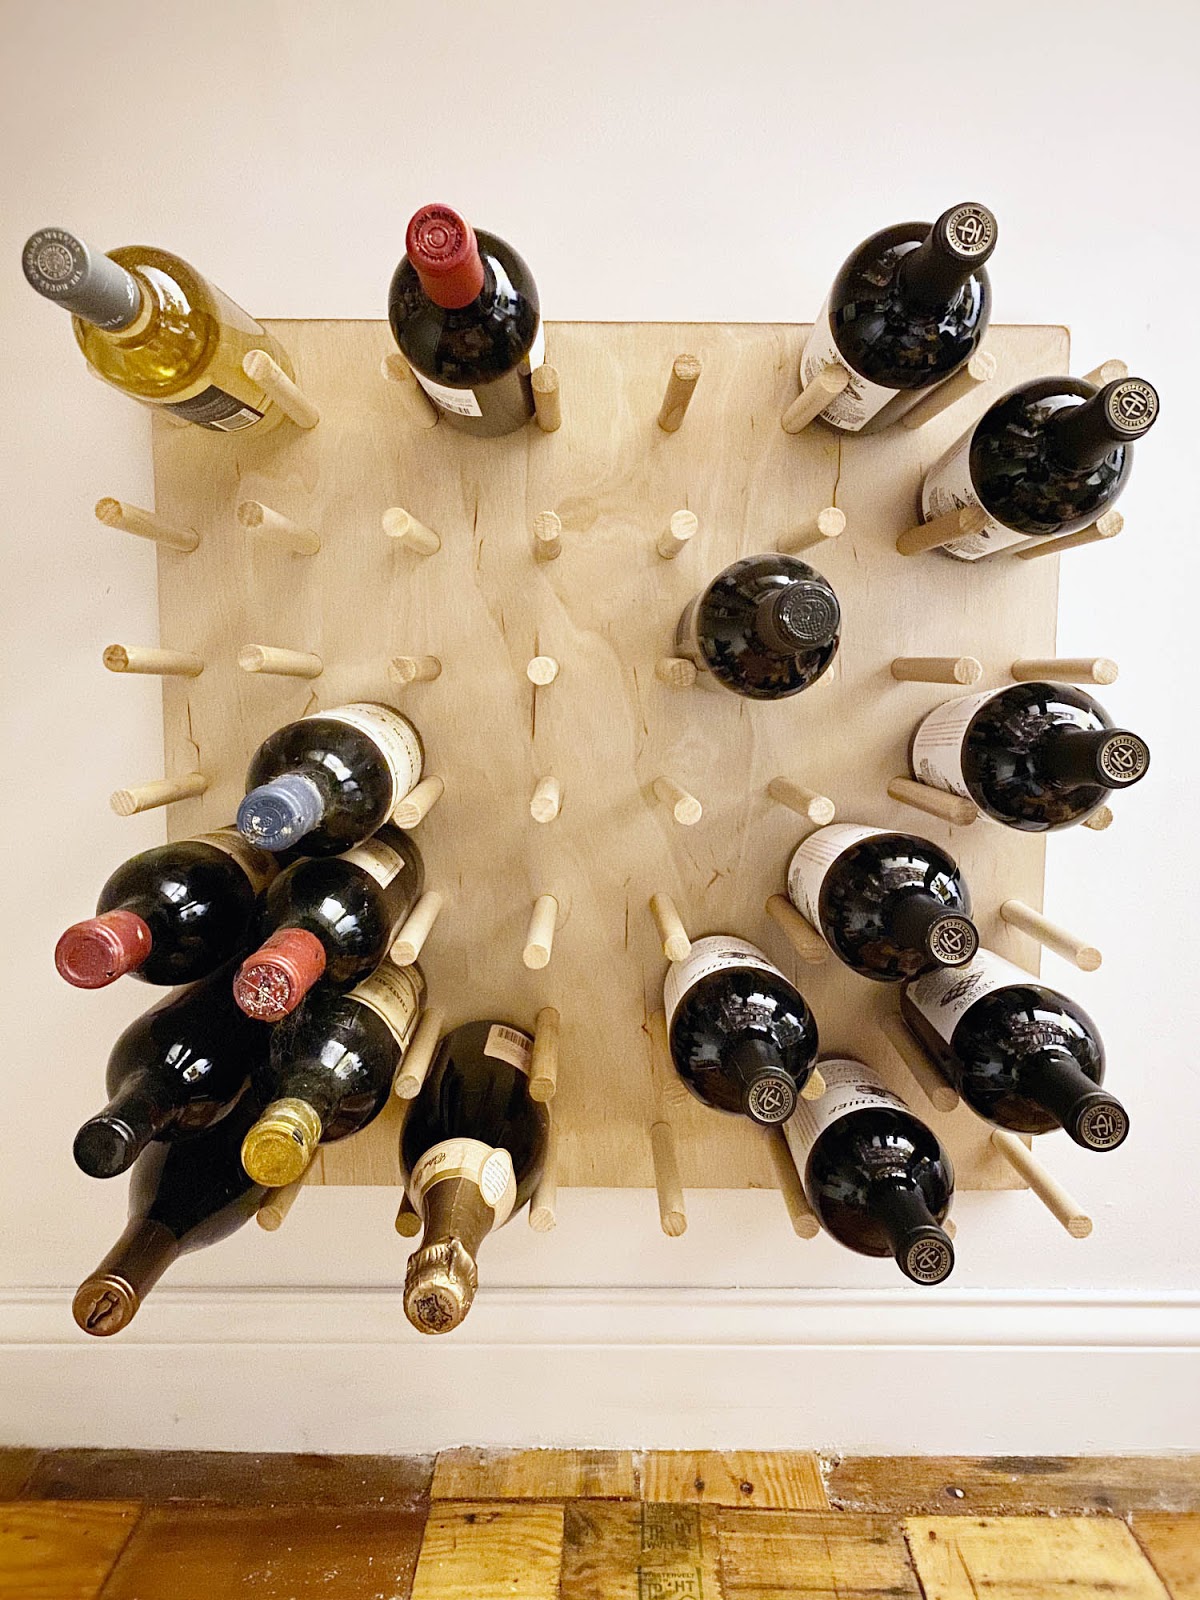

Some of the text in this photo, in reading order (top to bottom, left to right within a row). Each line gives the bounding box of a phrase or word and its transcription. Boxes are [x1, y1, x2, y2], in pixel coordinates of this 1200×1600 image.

[978, 212, 992, 235] COOPER
[1119, 385, 1143, 393] COOPER
[1109, 768, 1133, 777] COOPER
[938, 950, 960, 960] COOPER
[751, 1089, 759, 1113] COOPER
[758, 1080, 776, 1088] THIEF
[675, 1580, 695, 1592] HT
